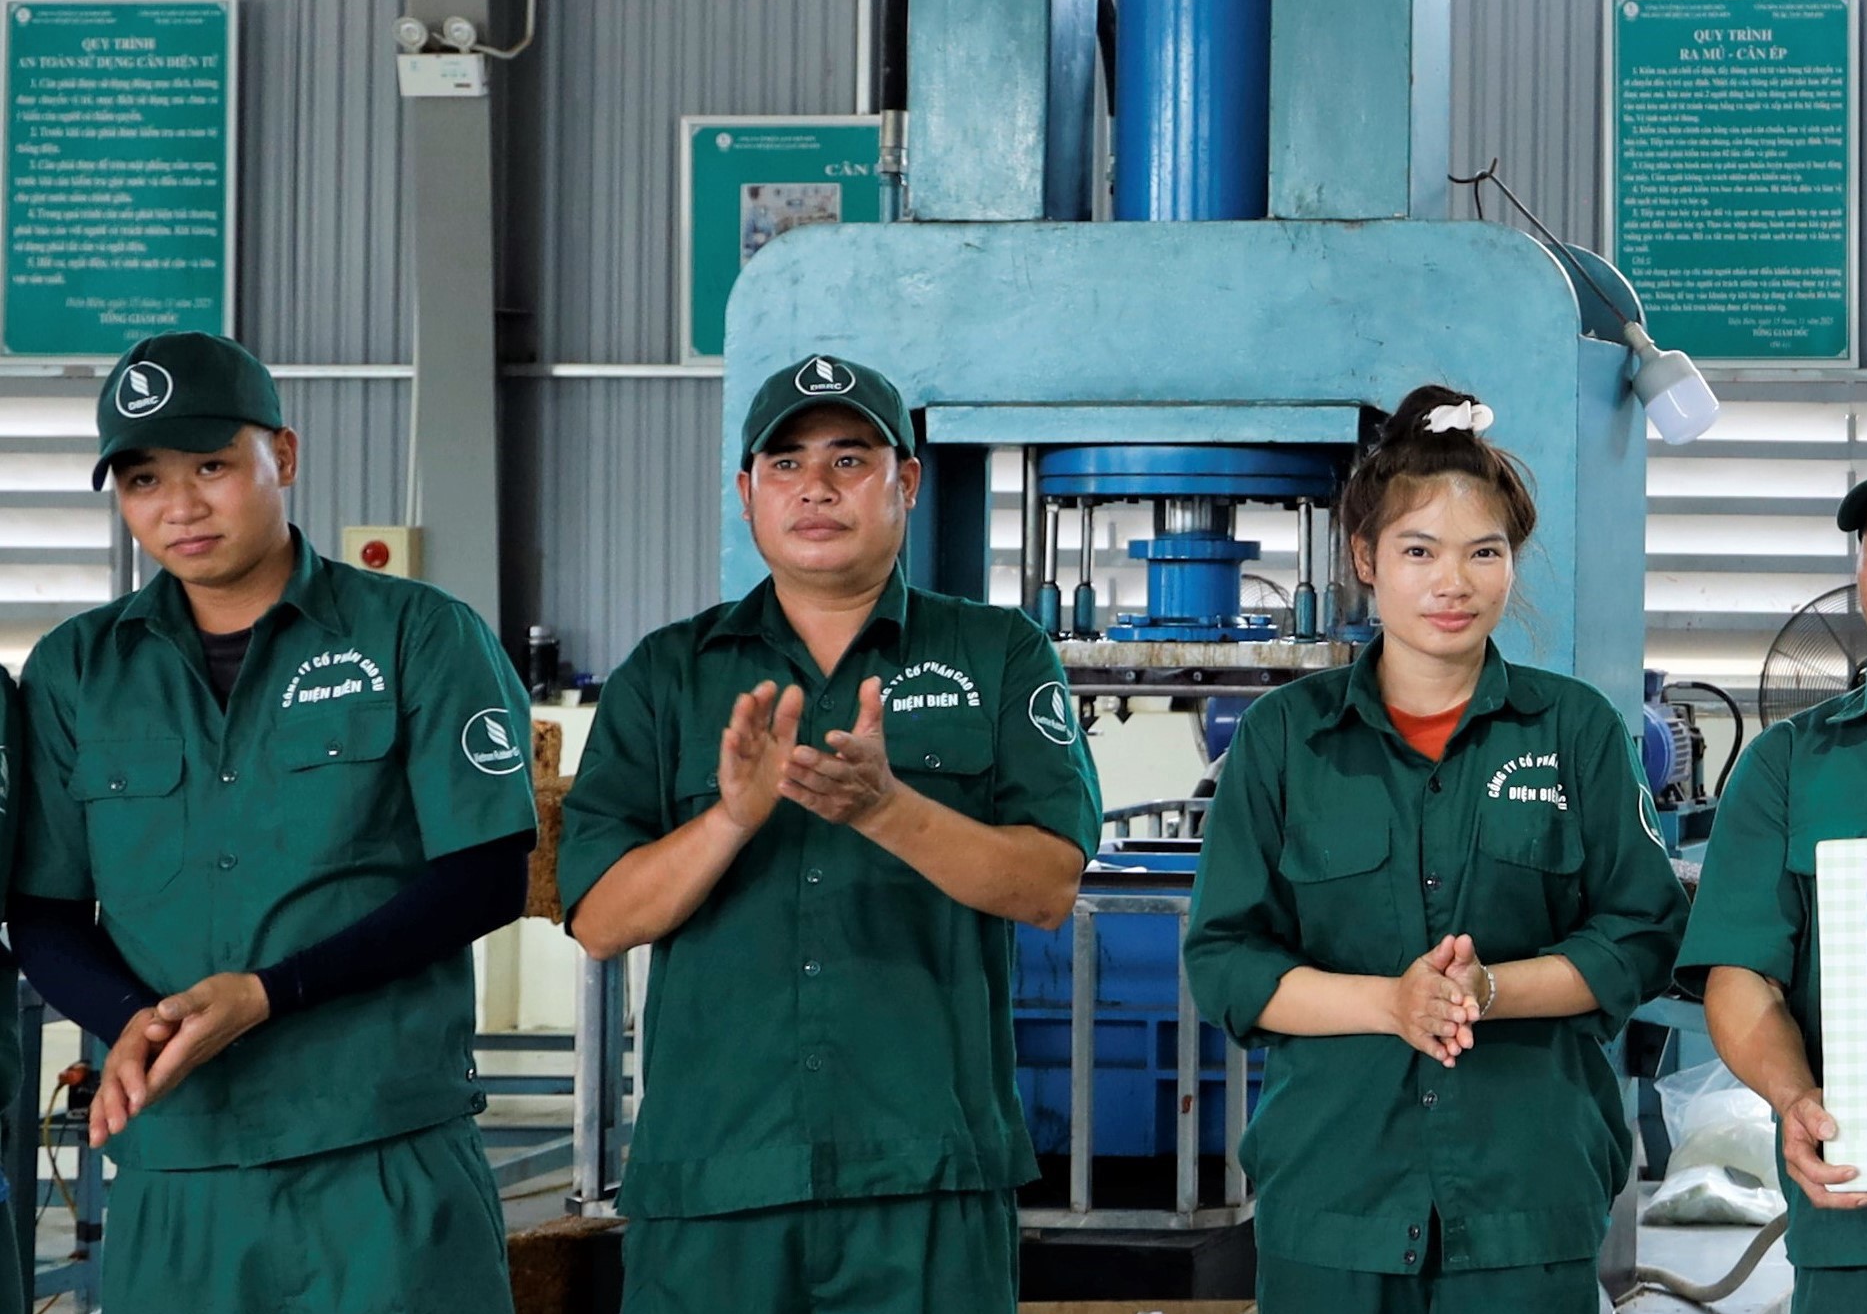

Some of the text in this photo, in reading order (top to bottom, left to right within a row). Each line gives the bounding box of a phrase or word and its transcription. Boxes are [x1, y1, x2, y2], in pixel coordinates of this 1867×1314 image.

[1694, 25, 1773, 43] QUY TRÌNH
[1680, 47, 1700, 61] RA
